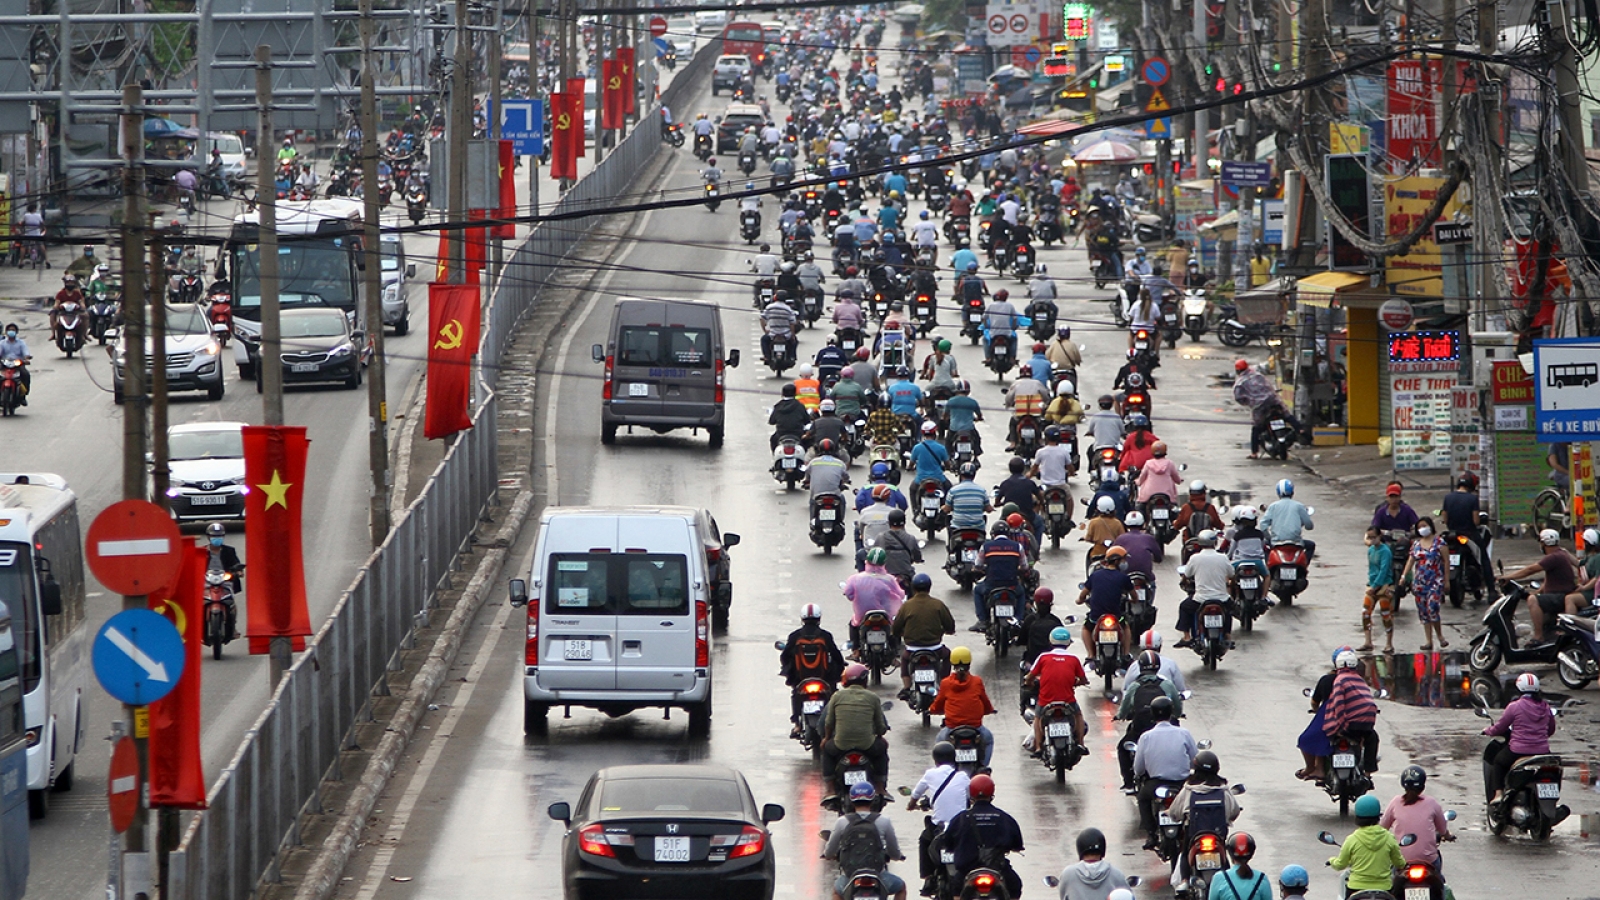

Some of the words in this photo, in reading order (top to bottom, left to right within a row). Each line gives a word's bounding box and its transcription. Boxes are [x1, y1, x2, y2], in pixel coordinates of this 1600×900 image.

[1542, 418, 1563, 433] BẾN
[1566, 420, 1579, 433] XE
[663, 838, 681, 849] 51F
